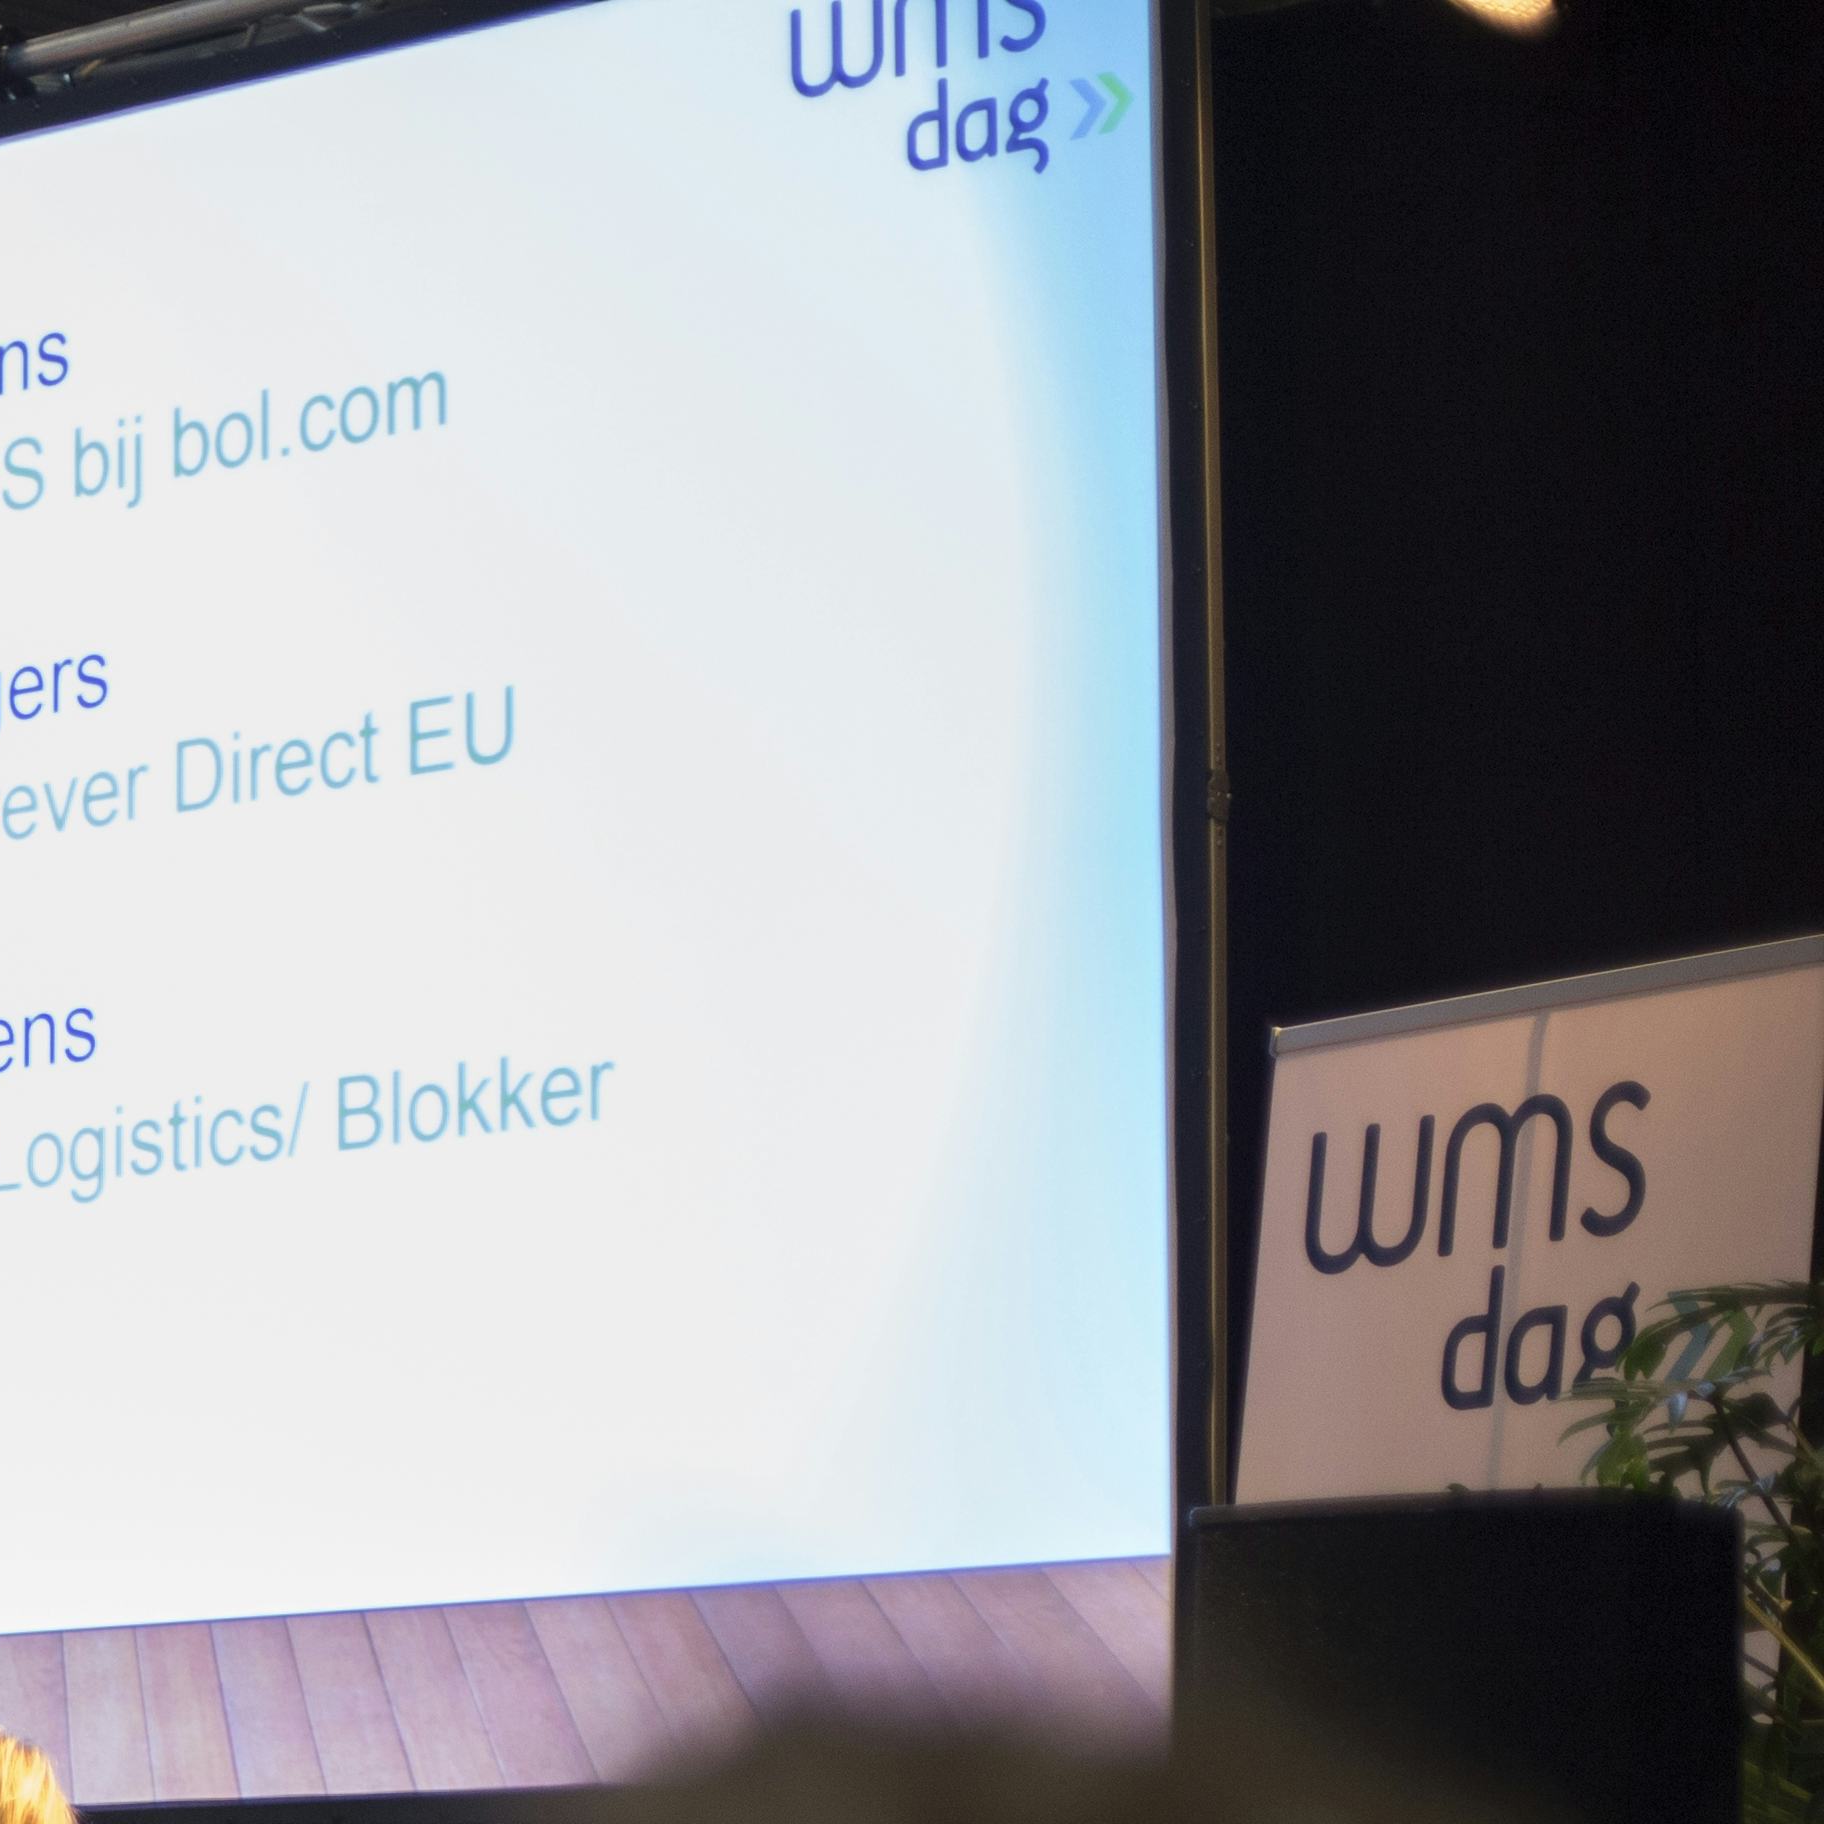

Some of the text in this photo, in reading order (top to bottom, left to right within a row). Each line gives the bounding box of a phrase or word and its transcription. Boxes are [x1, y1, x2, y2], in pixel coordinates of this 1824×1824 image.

[906, 77, 1051, 175] dag
[73, 417, 145, 510] bij
[172, 370, 448, 479] bol.com
[175, 711, 381, 814] Direct
[408, 684, 515, 777] EU
[337, 1055, 616, 1152] Blokker
[1304, 1080, 1651, 1275] wms
